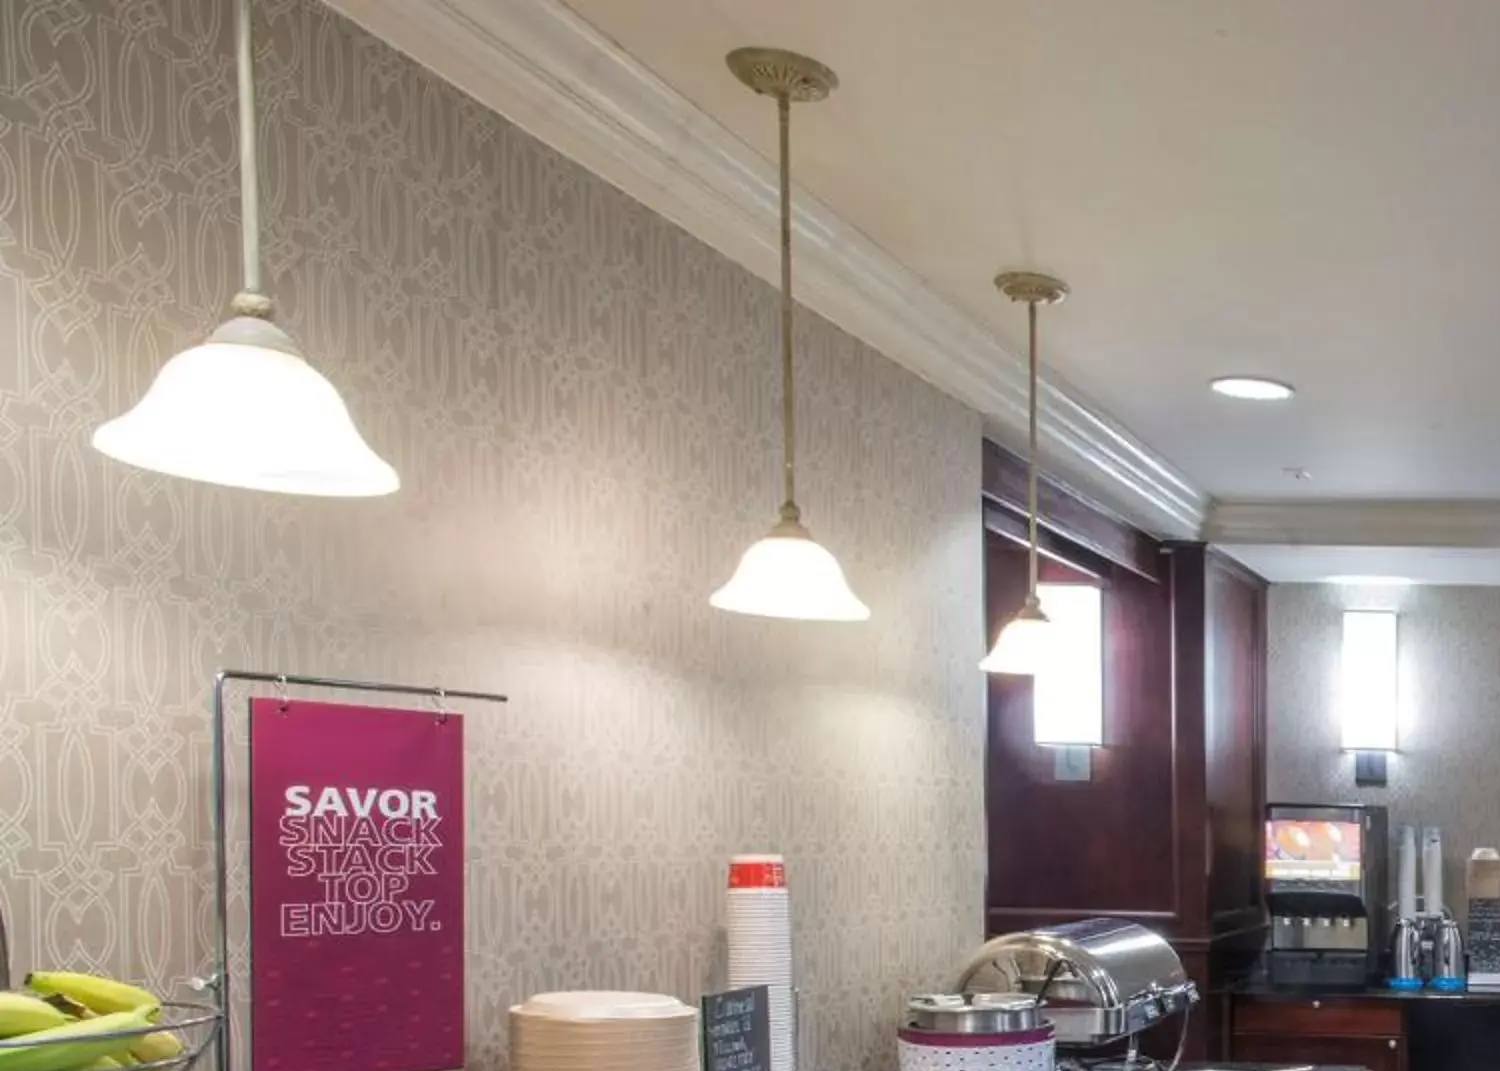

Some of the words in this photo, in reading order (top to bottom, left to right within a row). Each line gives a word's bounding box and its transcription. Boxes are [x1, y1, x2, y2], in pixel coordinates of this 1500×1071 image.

[285, 786, 438, 818] SAVOR
[279, 815, 443, 846] SNACK
[287, 844, 438, 876] STACK
[317, 872, 409, 904] TOP
[281, 899, 441, 937] ENJOY.
